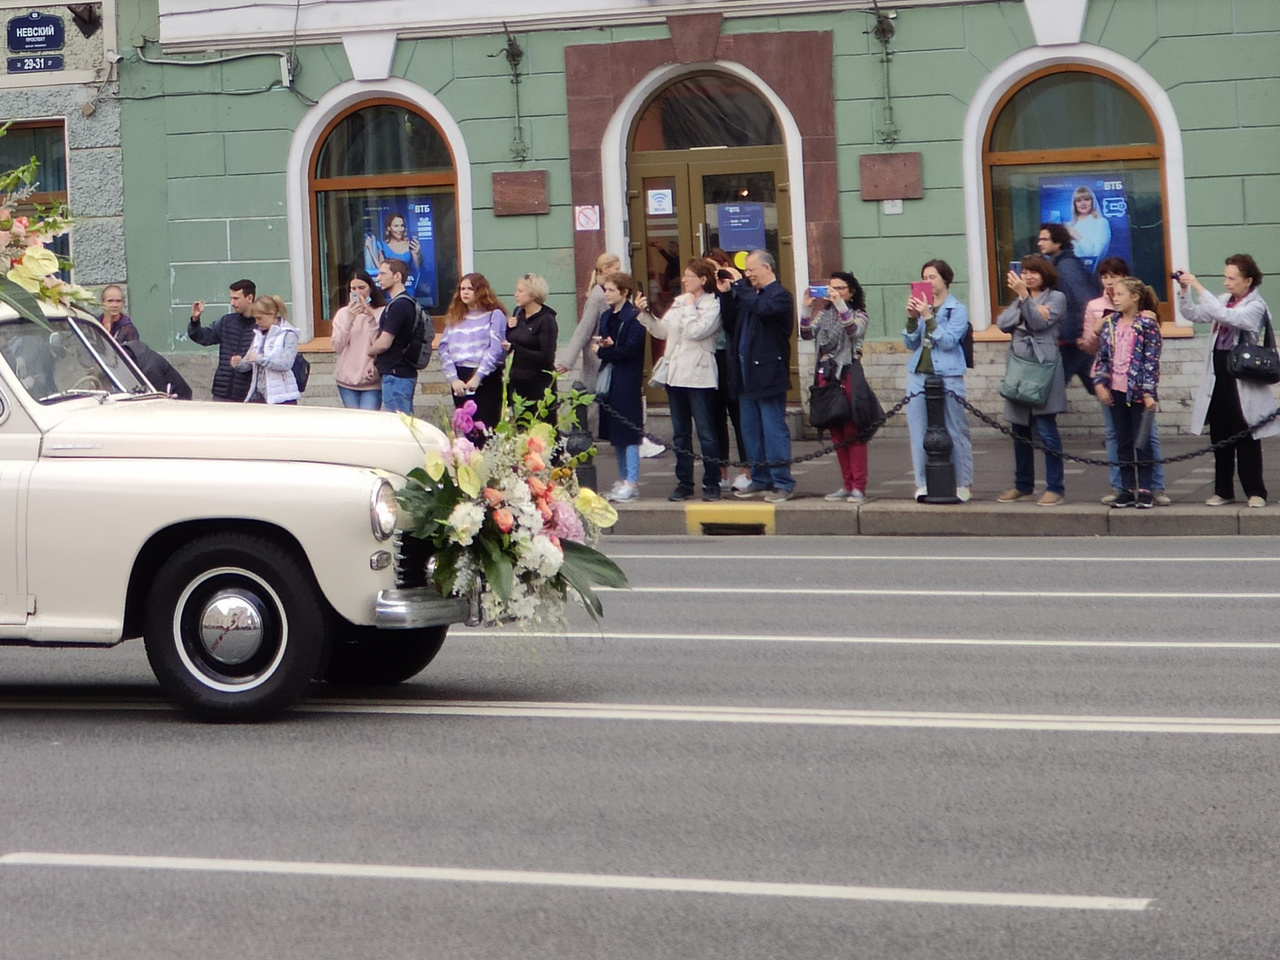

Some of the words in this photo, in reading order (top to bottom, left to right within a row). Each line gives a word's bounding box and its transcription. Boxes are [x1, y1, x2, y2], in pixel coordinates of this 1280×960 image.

[16, 24, 55, 37] НЕВСКИЙ
[23, 57, 45, 70] 29-31
[1104, 181, 1123, 190] ВТБ
[414, 204, 431, 213] ВТБ
